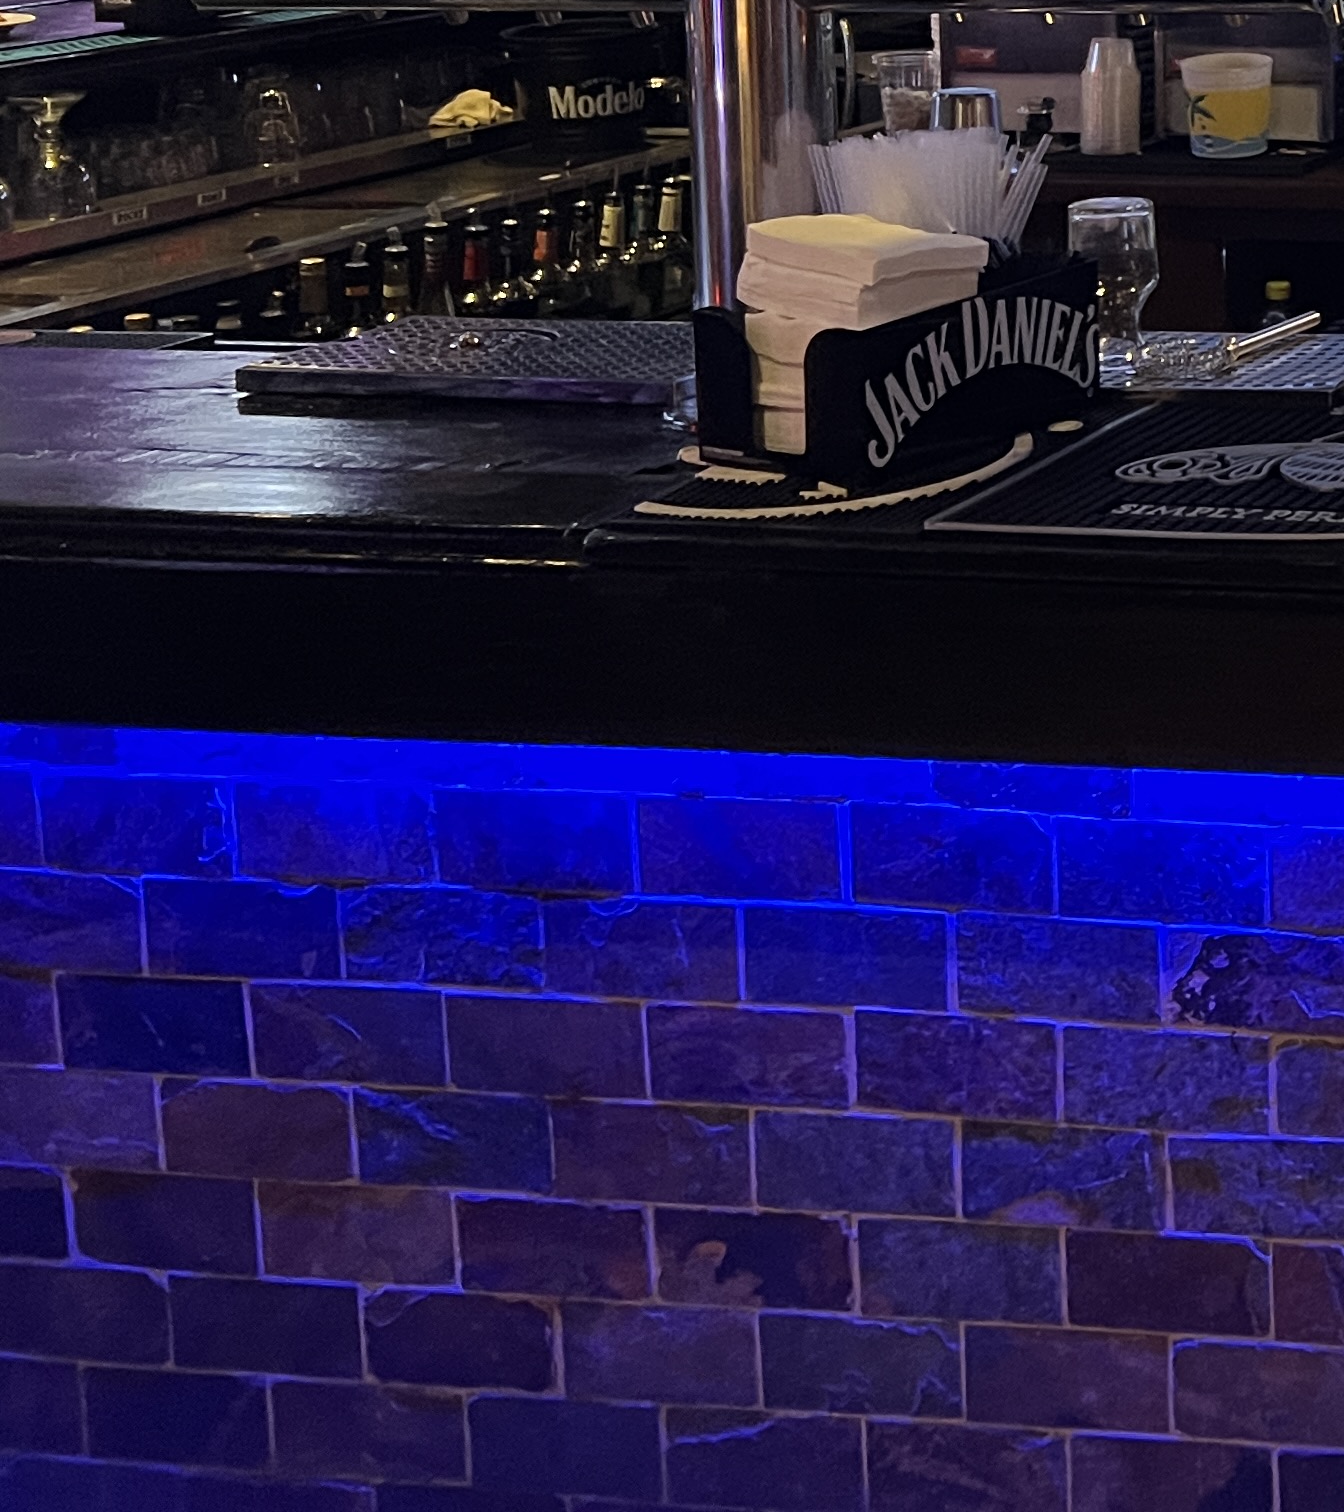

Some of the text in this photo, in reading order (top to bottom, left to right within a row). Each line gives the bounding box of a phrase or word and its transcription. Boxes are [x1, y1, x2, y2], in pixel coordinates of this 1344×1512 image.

[547, 84, 647, 121] Modelo
[864, 296, 1100, 469] JACK DANIEL'S
[1111, 502, 1252, 521] SIMPLY
